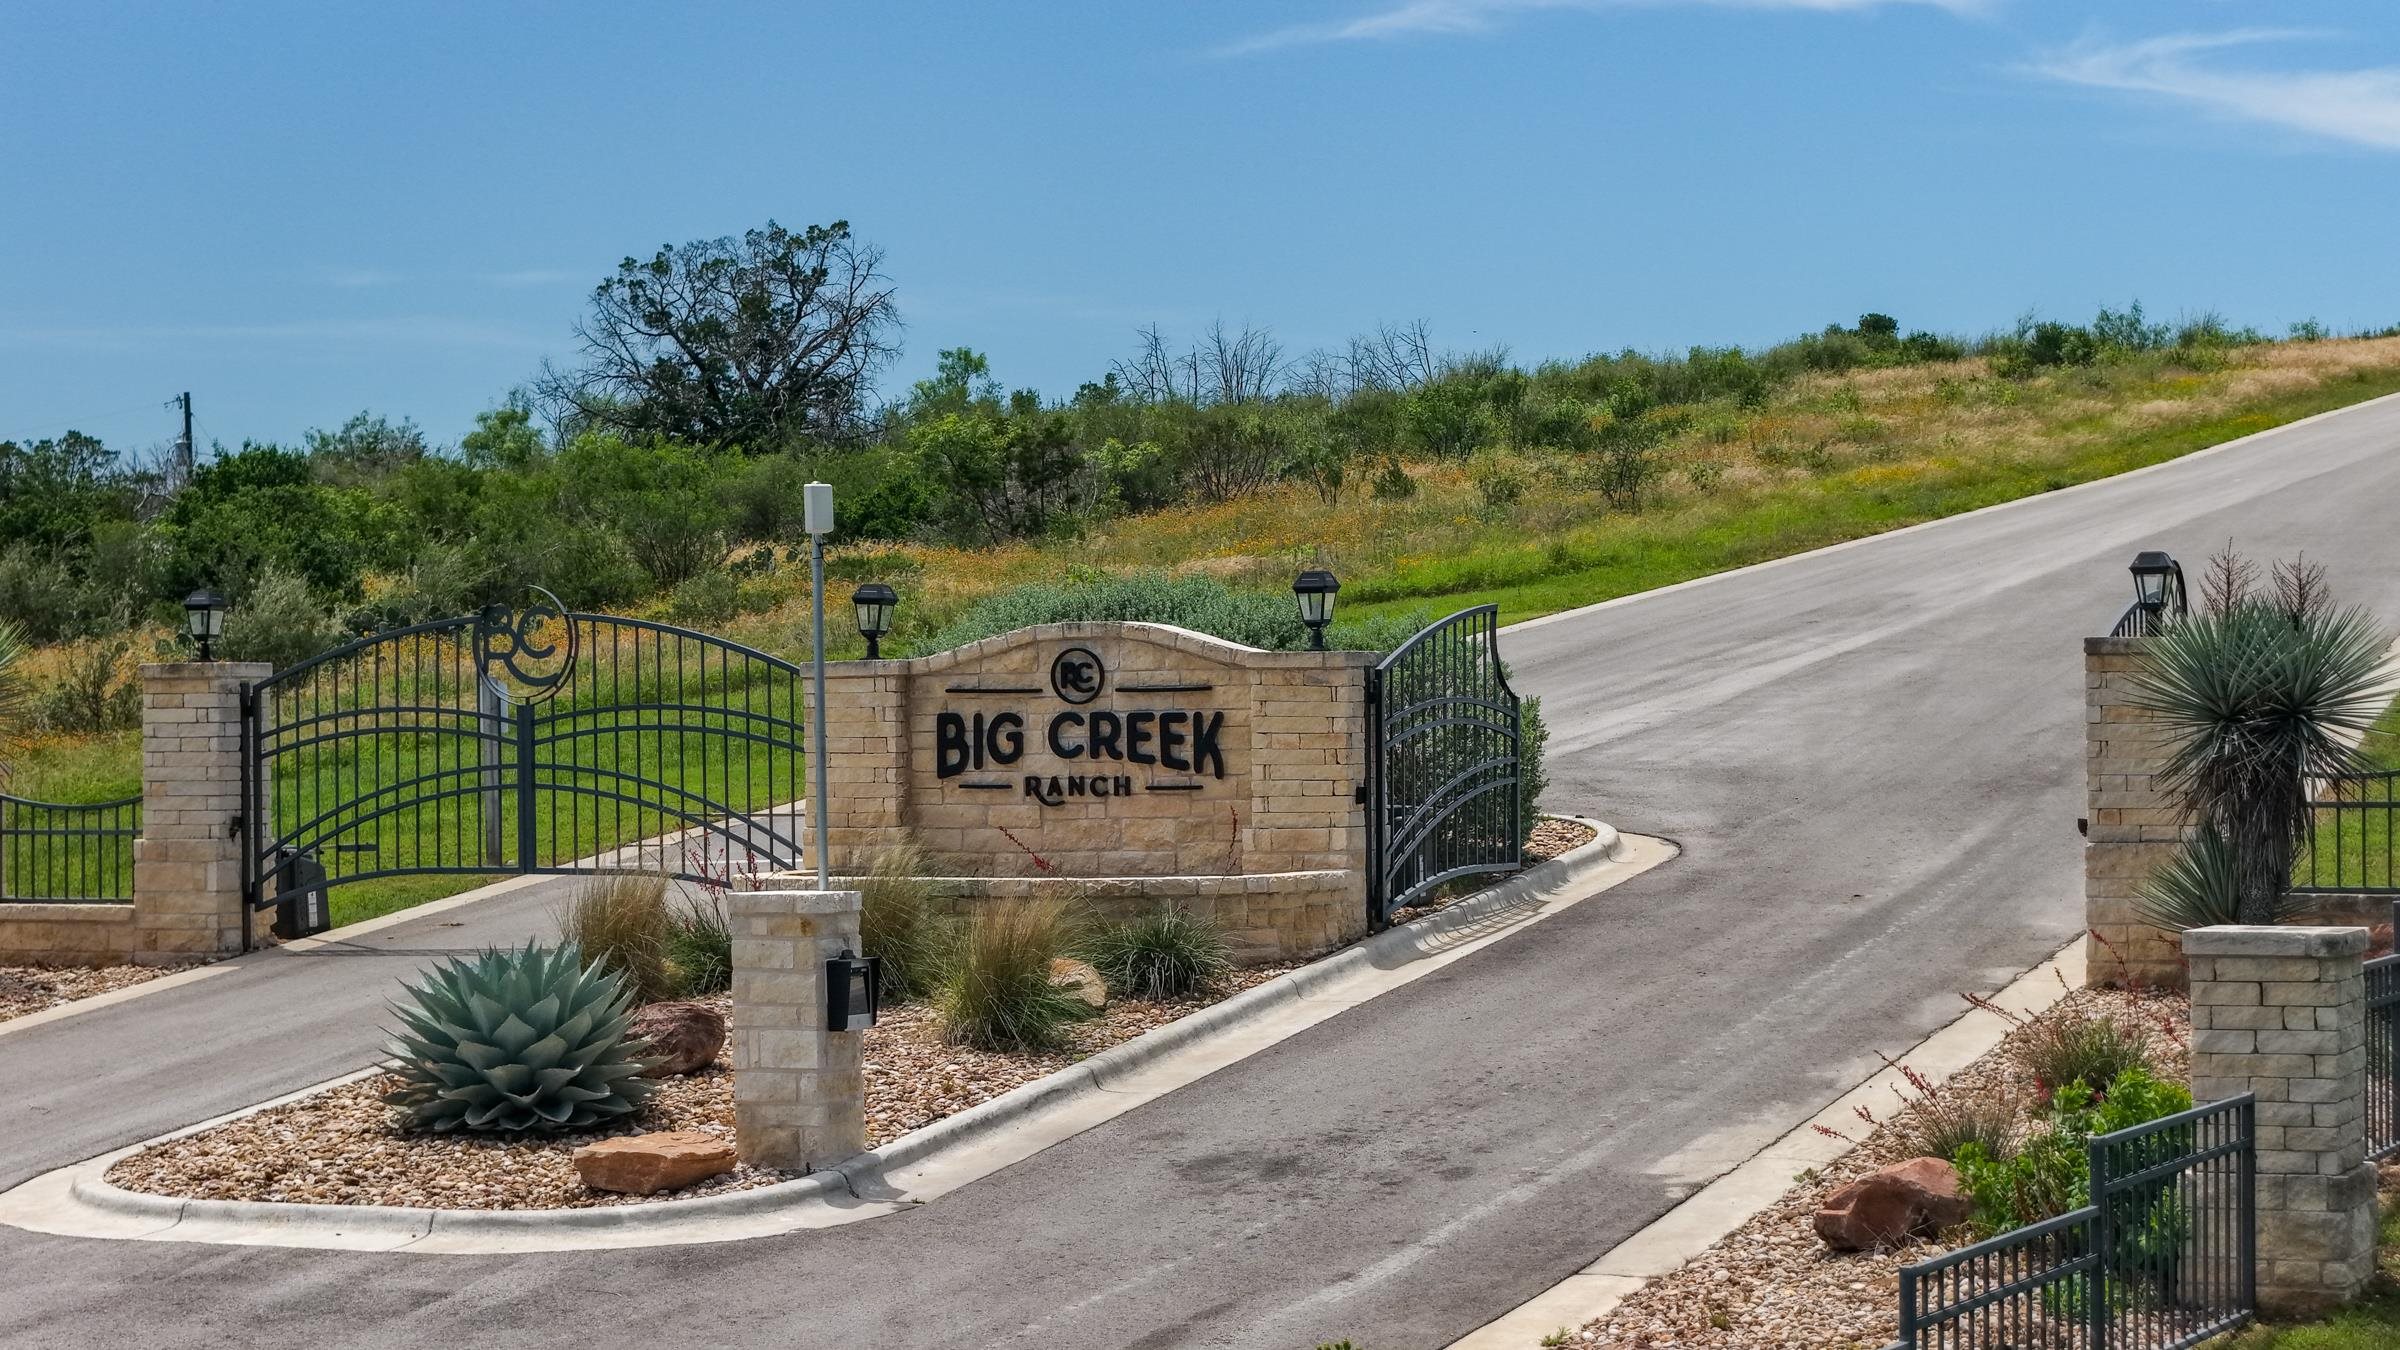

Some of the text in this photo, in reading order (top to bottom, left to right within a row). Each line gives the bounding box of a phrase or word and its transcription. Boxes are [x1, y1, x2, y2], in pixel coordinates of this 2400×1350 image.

[936, 711, 1225, 780] BIG CREEK
[1024, 775, 1131, 807] RANCH
